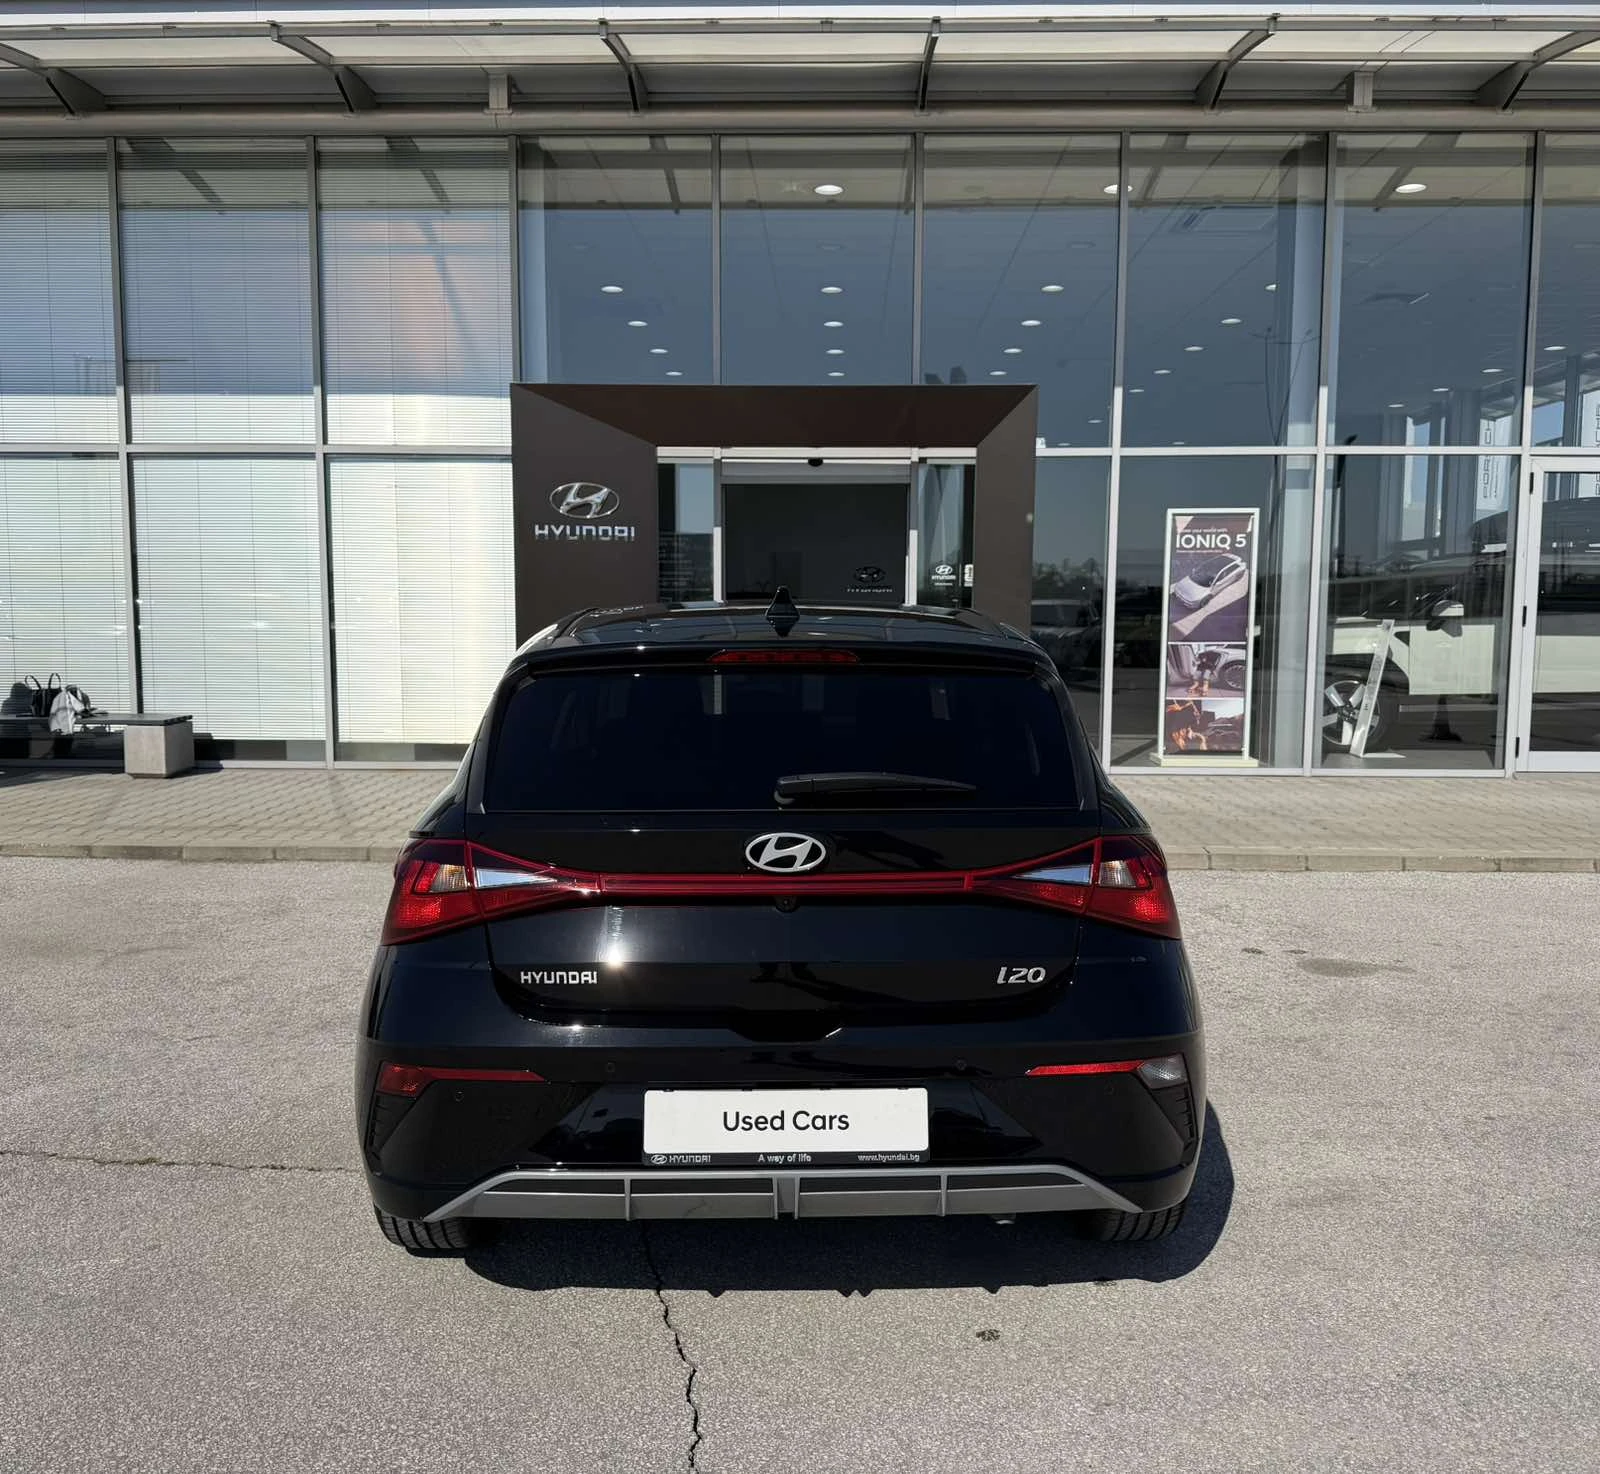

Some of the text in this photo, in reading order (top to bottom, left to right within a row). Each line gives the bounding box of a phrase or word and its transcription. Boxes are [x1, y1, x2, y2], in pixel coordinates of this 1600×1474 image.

[534, 525, 636, 542] HYUNDAI
[1176, 533, 1247, 550] IONIQ 5
[520, 971, 598, 985] HYUNDAI
[723, 1110, 849, 1132] Used Cars
[669, 1154, 711, 1163] HYUNDAI
[758, 1153, 812, 1164] A way of life
[857, 1152, 920, 1163] www.hyundai.bg
